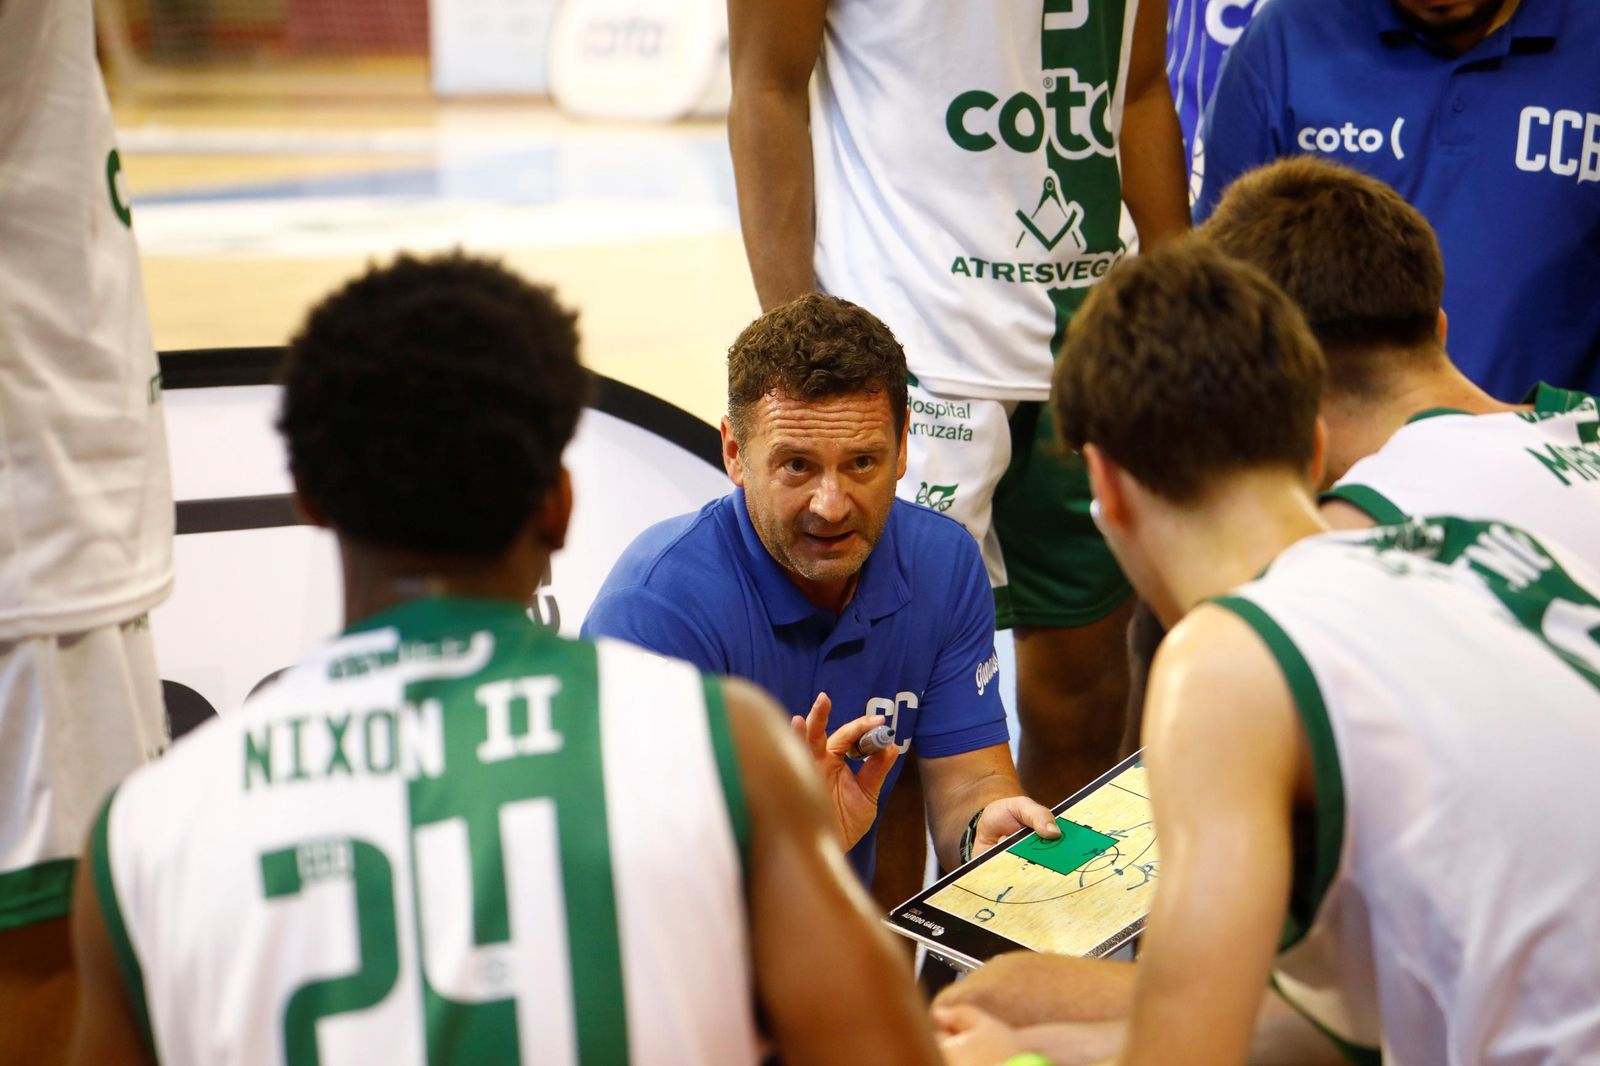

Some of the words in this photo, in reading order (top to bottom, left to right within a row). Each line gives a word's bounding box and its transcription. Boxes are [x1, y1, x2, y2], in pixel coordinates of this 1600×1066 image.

[1298, 122, 1383, 153] coto
[1515, 105, 1600, 185] CCB
[951, 256, 1115, 284] ATRESVEG
[242, 698, 445, 792] NIXON
[475, 675, 564, 763] II
[259, 797, 580, 1066] 24
